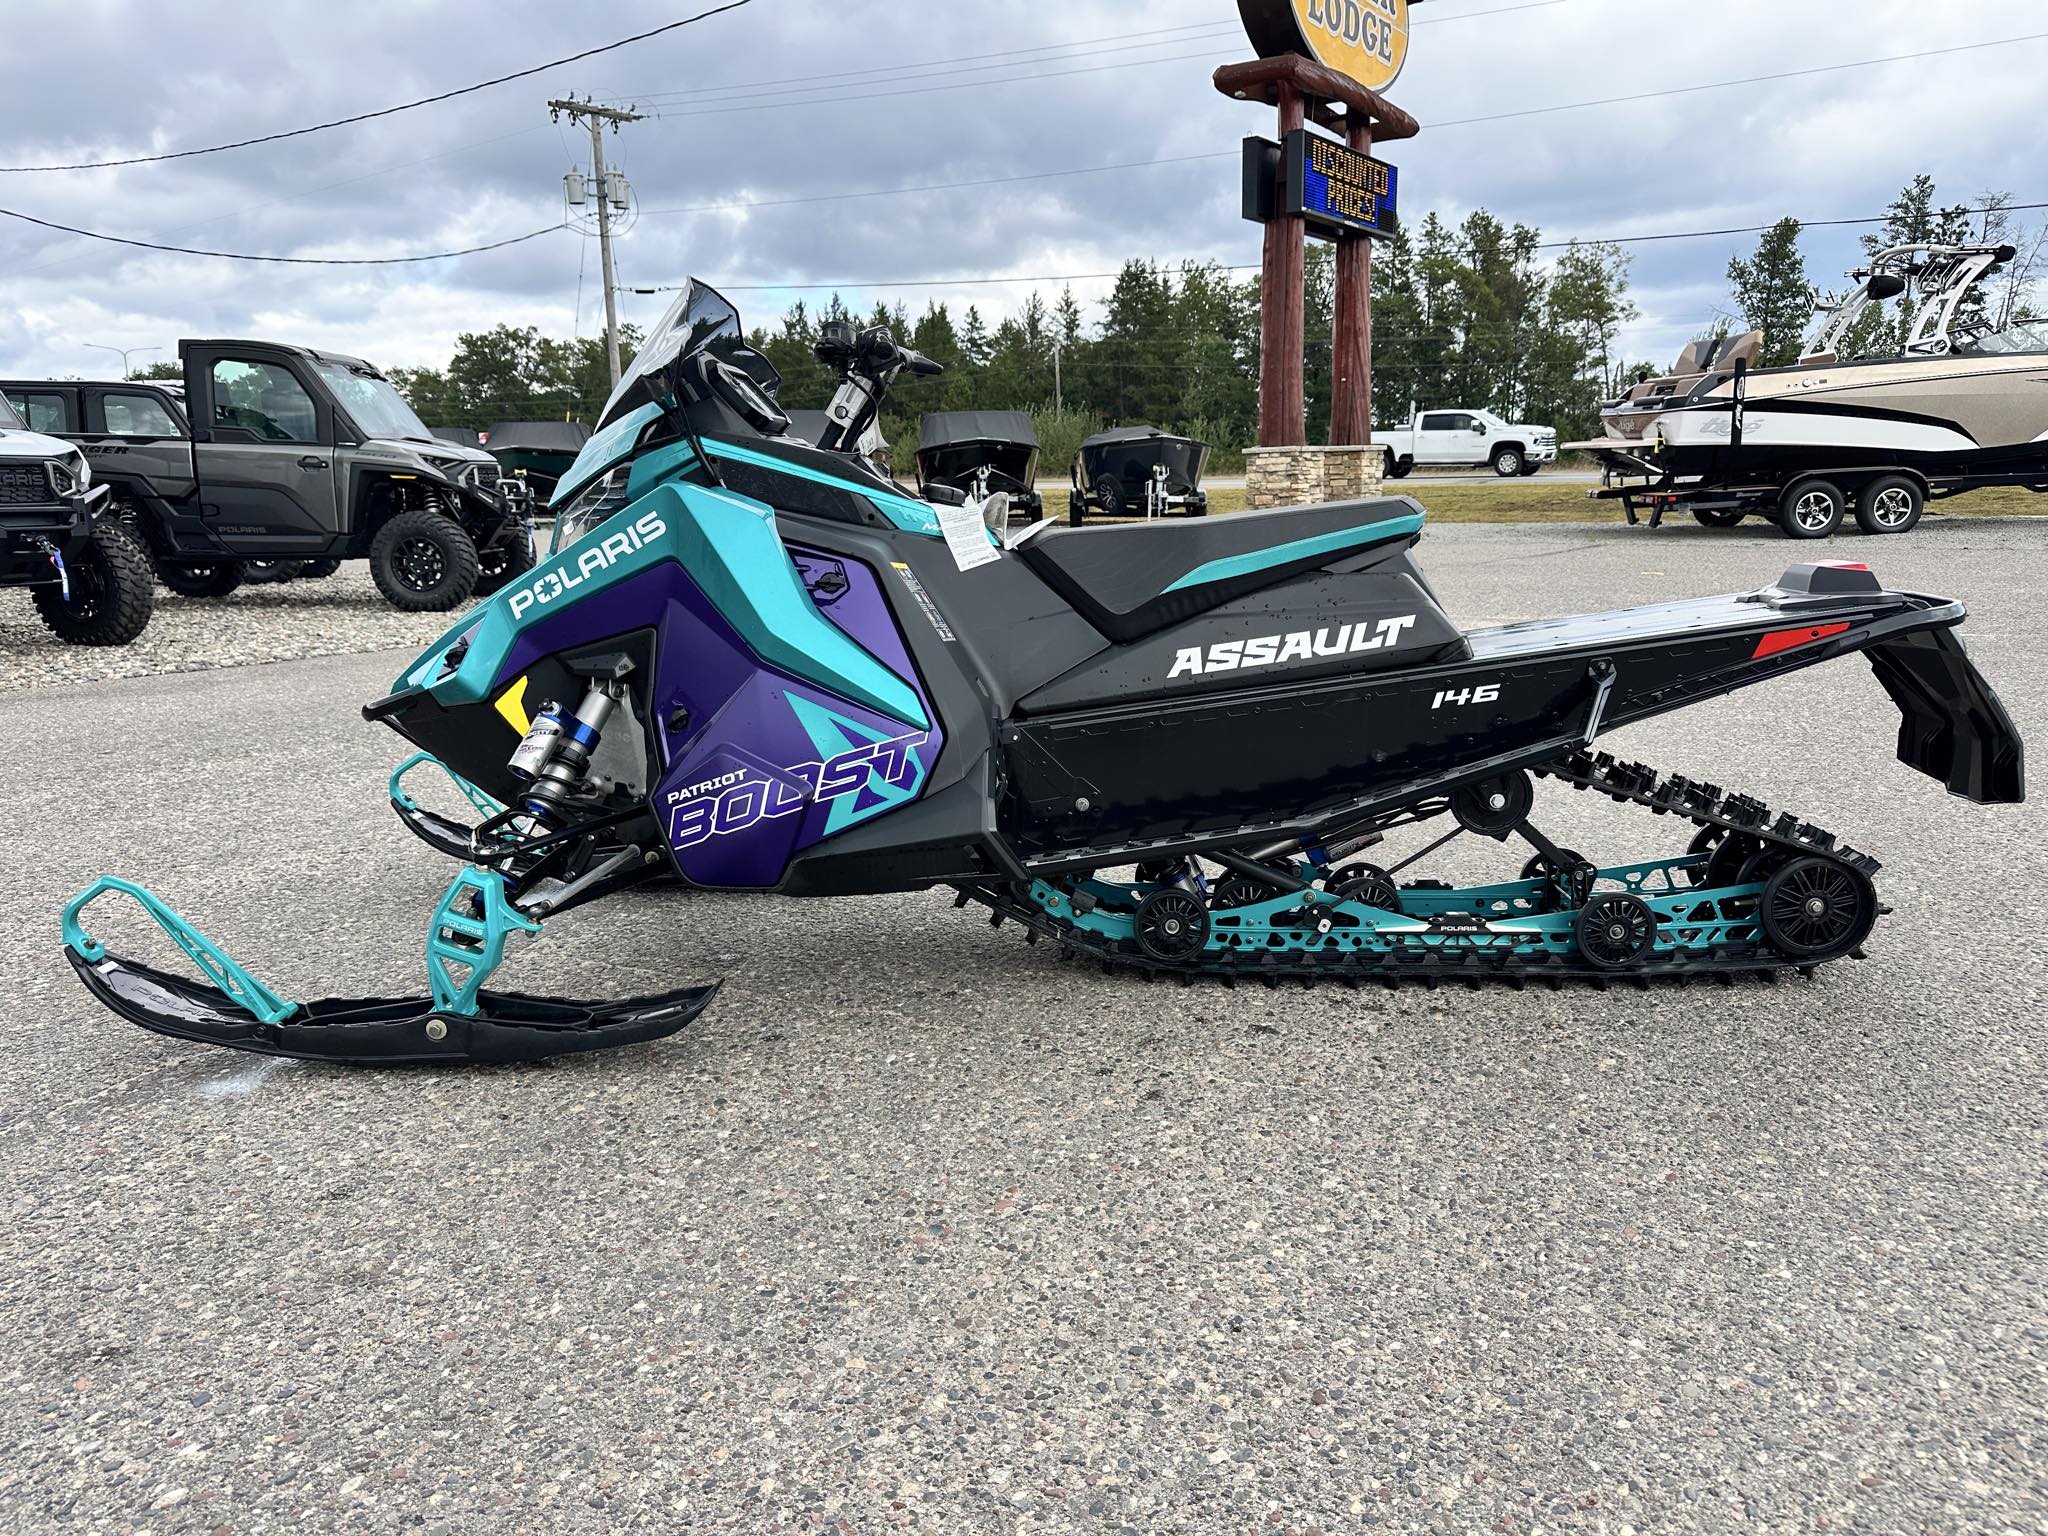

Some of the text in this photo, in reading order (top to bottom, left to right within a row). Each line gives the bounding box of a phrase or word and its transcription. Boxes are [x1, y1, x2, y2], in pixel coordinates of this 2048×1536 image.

[1308, 0, 1392, 63] LODGE
[1312, 139, 1388, 196] DISCOUNTED
[1327, 178, 1376, 223] PRICES!
[218, 526, 267, 534] POLARIS
[508, 511, 667, 620] POLARIS
[1166, 614, 1417, 679] ASSAULT
[1430, 683, 1501, 709] 146
[667, 768, 748, 805] PATRIOT
[668, 730, 930, 850] BOOST
[442, 918, 484, 936] POLARIS
